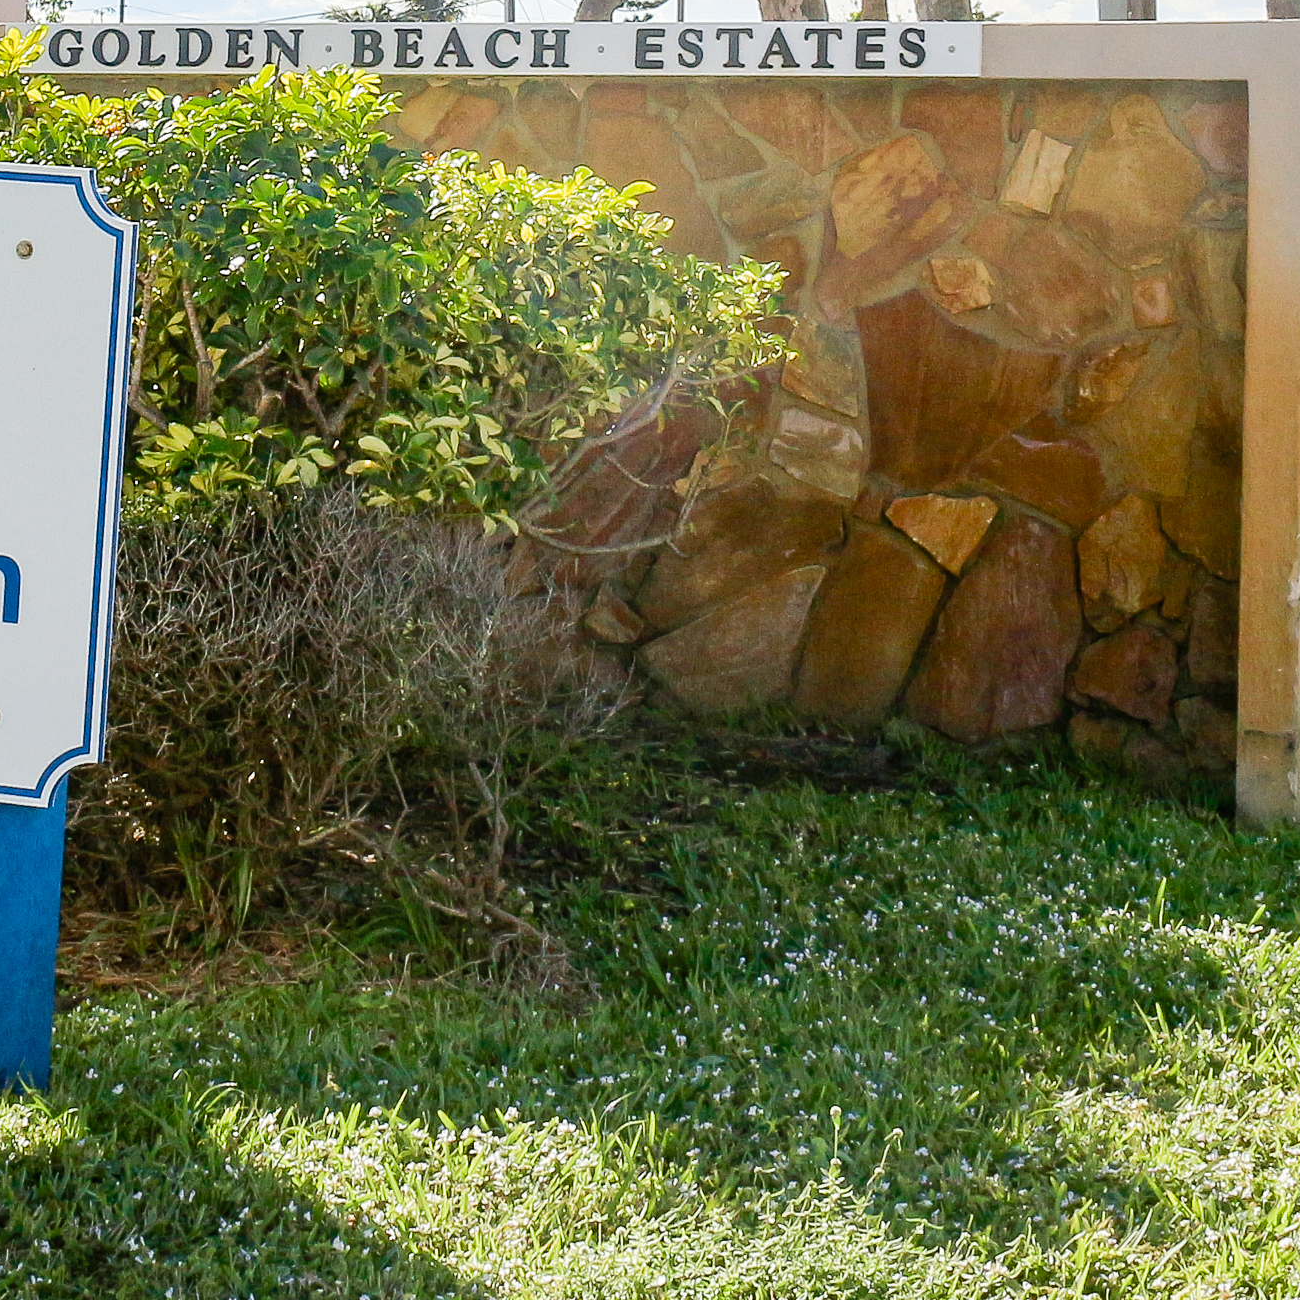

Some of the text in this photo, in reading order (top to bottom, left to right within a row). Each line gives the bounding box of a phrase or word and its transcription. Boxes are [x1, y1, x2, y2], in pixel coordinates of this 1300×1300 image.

[49, 26, 926, 69] GOLDEN BEACH ESTATES
